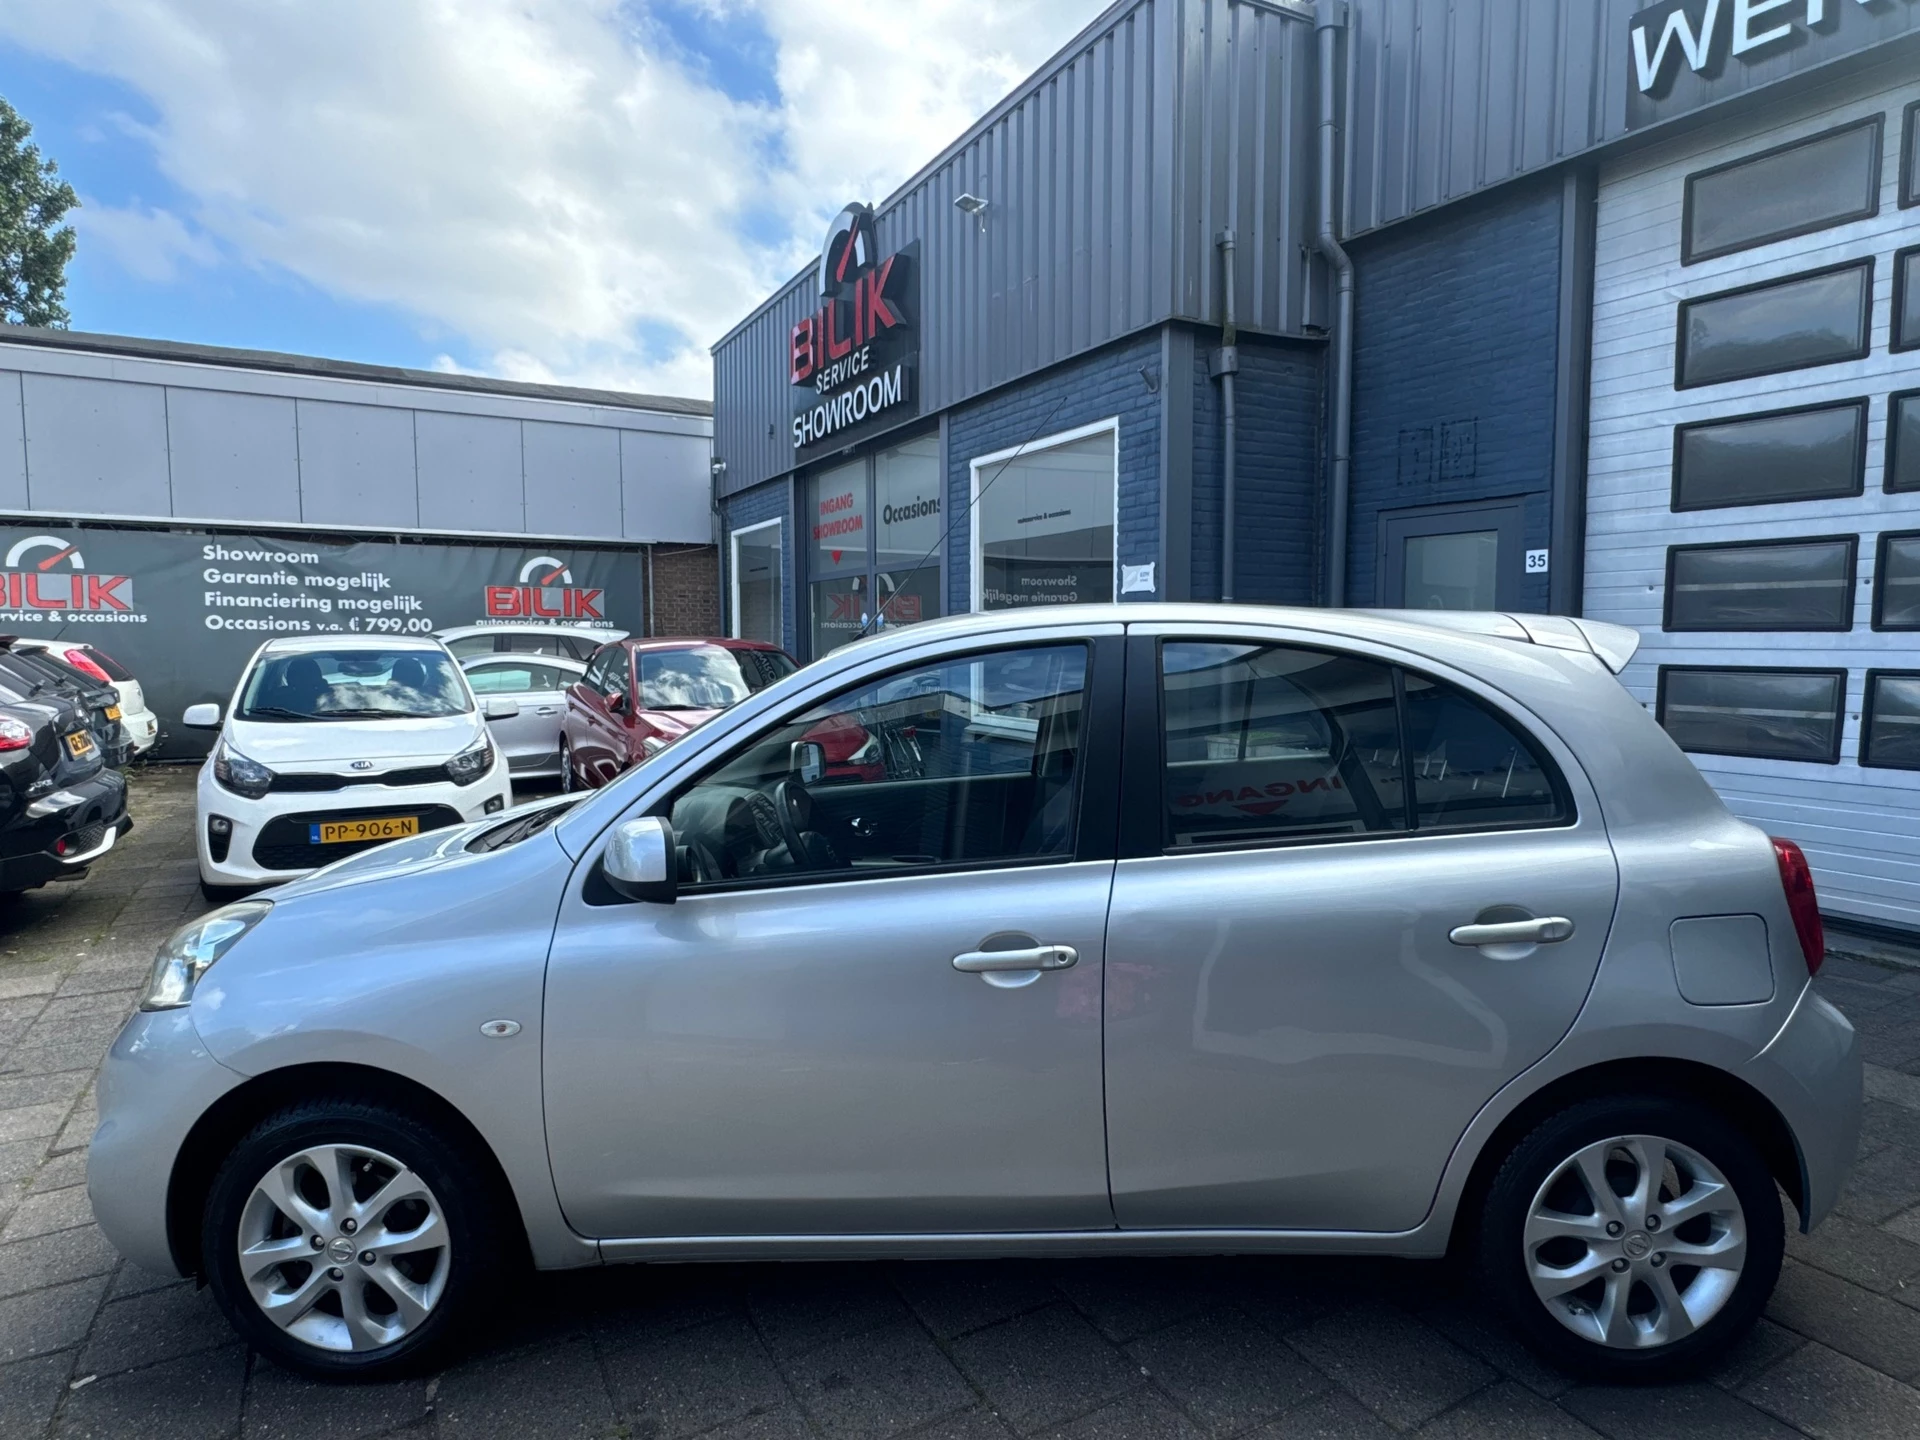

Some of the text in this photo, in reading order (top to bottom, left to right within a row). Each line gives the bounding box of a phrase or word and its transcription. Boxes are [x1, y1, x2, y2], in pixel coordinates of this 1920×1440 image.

[790, 253, 897, 385] BILIK
[816, 345, 870, 395] SERVICE
[793, 364, 901, 448] SHOWROOM
[820, 492, 854, 516] INGANG
[813, 514, 863, 540] SHOWROOM
[203, 545, 319, 564] Showroom
[1528, 554, 1546, 569] 35
[0, 572, 132, 610] ILIK
[203, 568, 391, 592] Garantie mogelijk
[204, 591, 423, 614] Financiering mogelijk
[487, 586, 604, 618] BILIK
[48, 611, 62, 622] &
[67, 611, 148, 623] occasions
[205, 614, 311, 631] Occasions
[316, 622, 343, 631] v.a.
[365, 617, 433, 634] 799,00
[325, 820, 412, 840] PP-906-N
